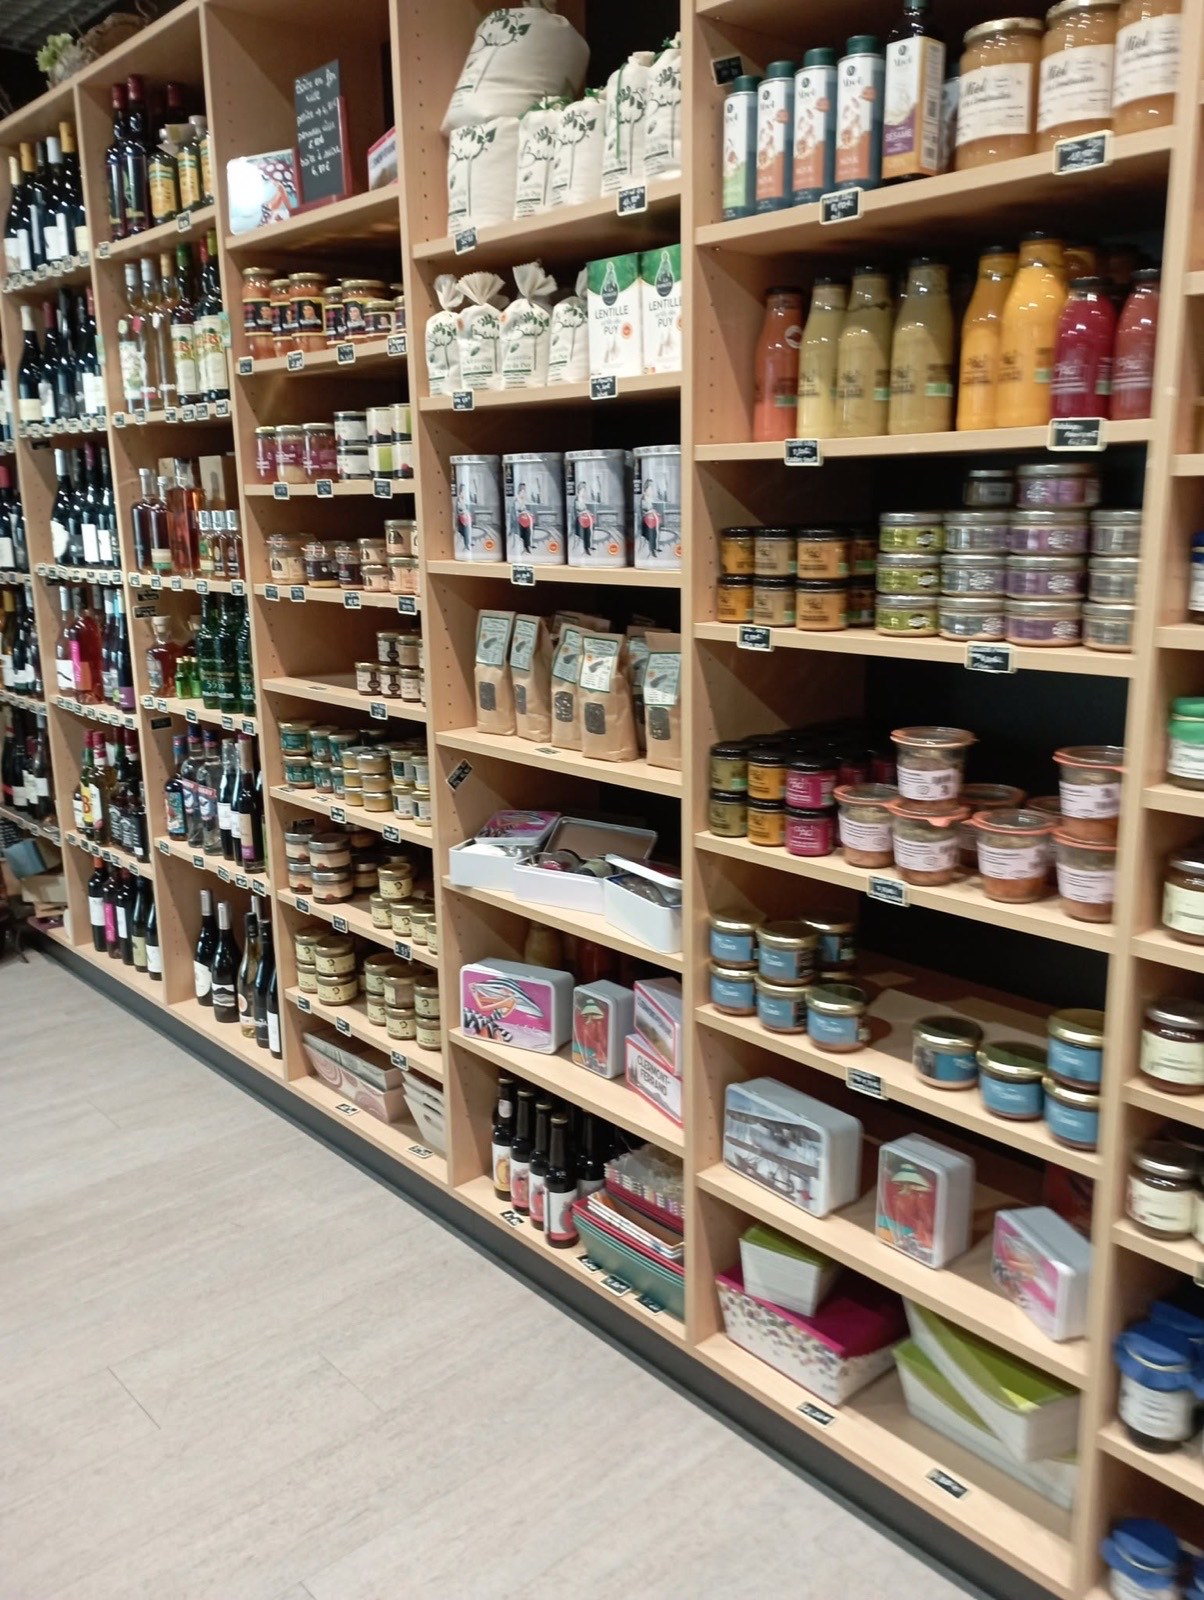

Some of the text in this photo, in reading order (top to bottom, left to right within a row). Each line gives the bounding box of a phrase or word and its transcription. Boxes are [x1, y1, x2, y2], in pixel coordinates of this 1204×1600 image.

[595, 305, 629, 319] LENTILLE
[657, 317, 673, 328] PUY
[603, 326, 619, 335] PUY
[637, 1055, 671, 1086] CLERMONT-
[641, 1069, 667, 1096] FERRAND
